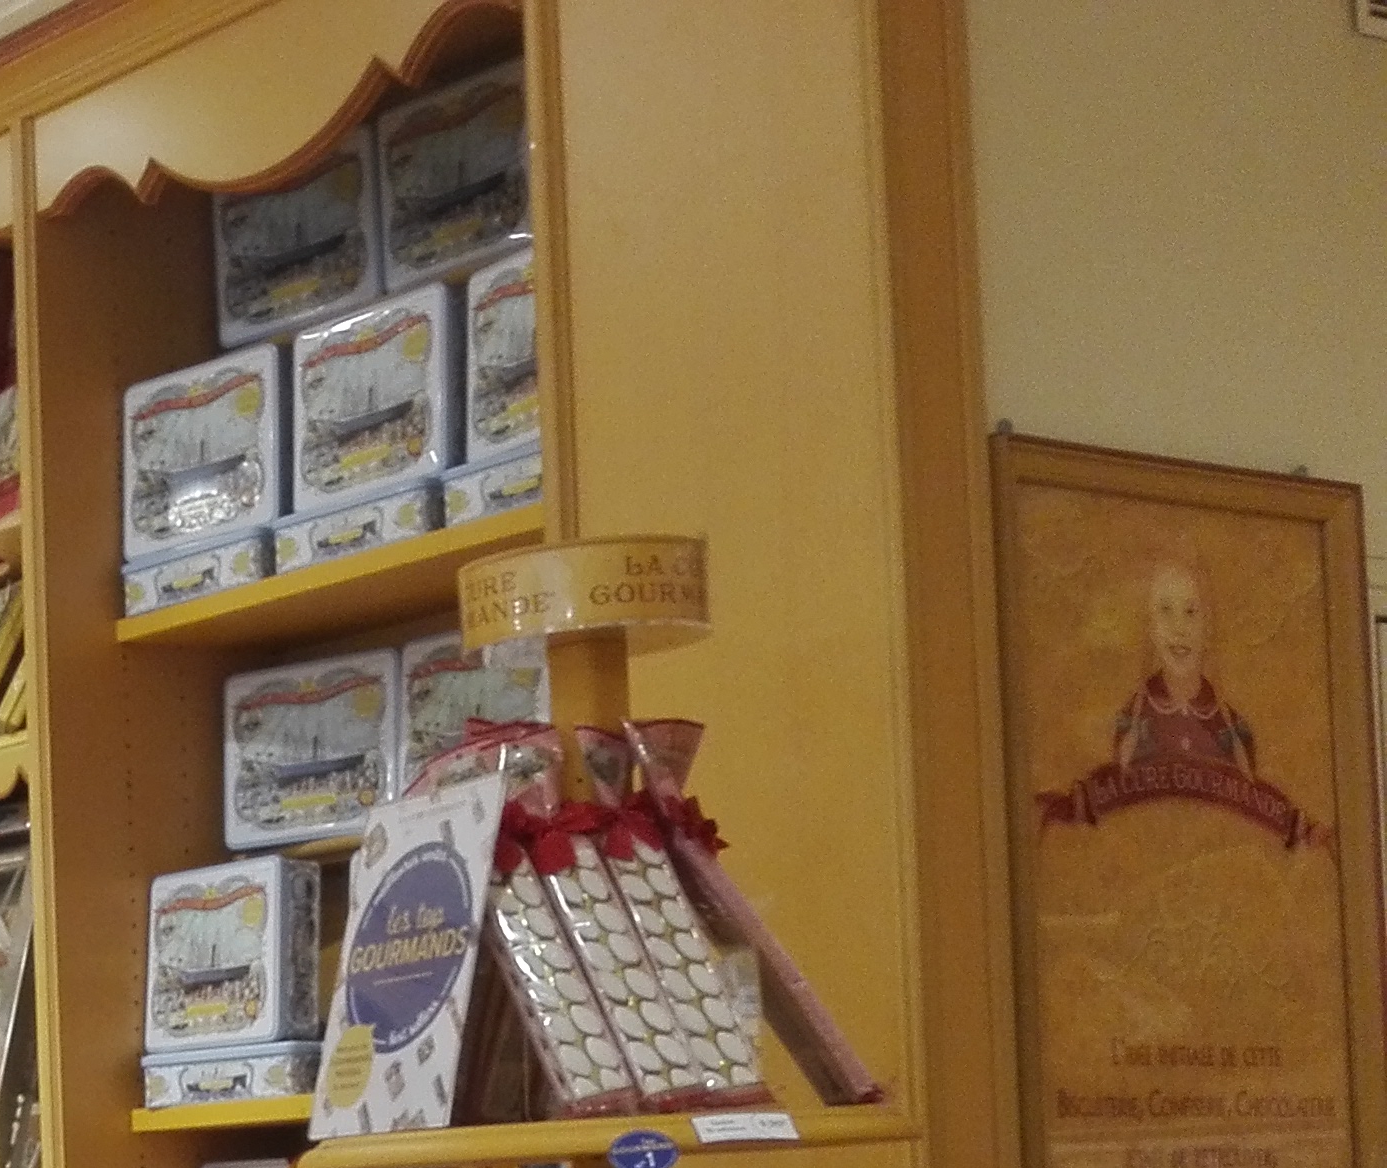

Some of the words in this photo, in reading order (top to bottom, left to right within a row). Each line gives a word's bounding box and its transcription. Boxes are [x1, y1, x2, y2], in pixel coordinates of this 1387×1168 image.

[625, 554, 664, 577] LA
[464, 571, 517, 603] URE
[1121, 764, 1170, 794] CURE
[1173, 763, 1289, 822] GOURMANDE
[350, 925, 469, 973] GOURMANDS
[1220, 1045, 1237, 1068] DE
[1243, 1045, 1282, 1068] CETTE
